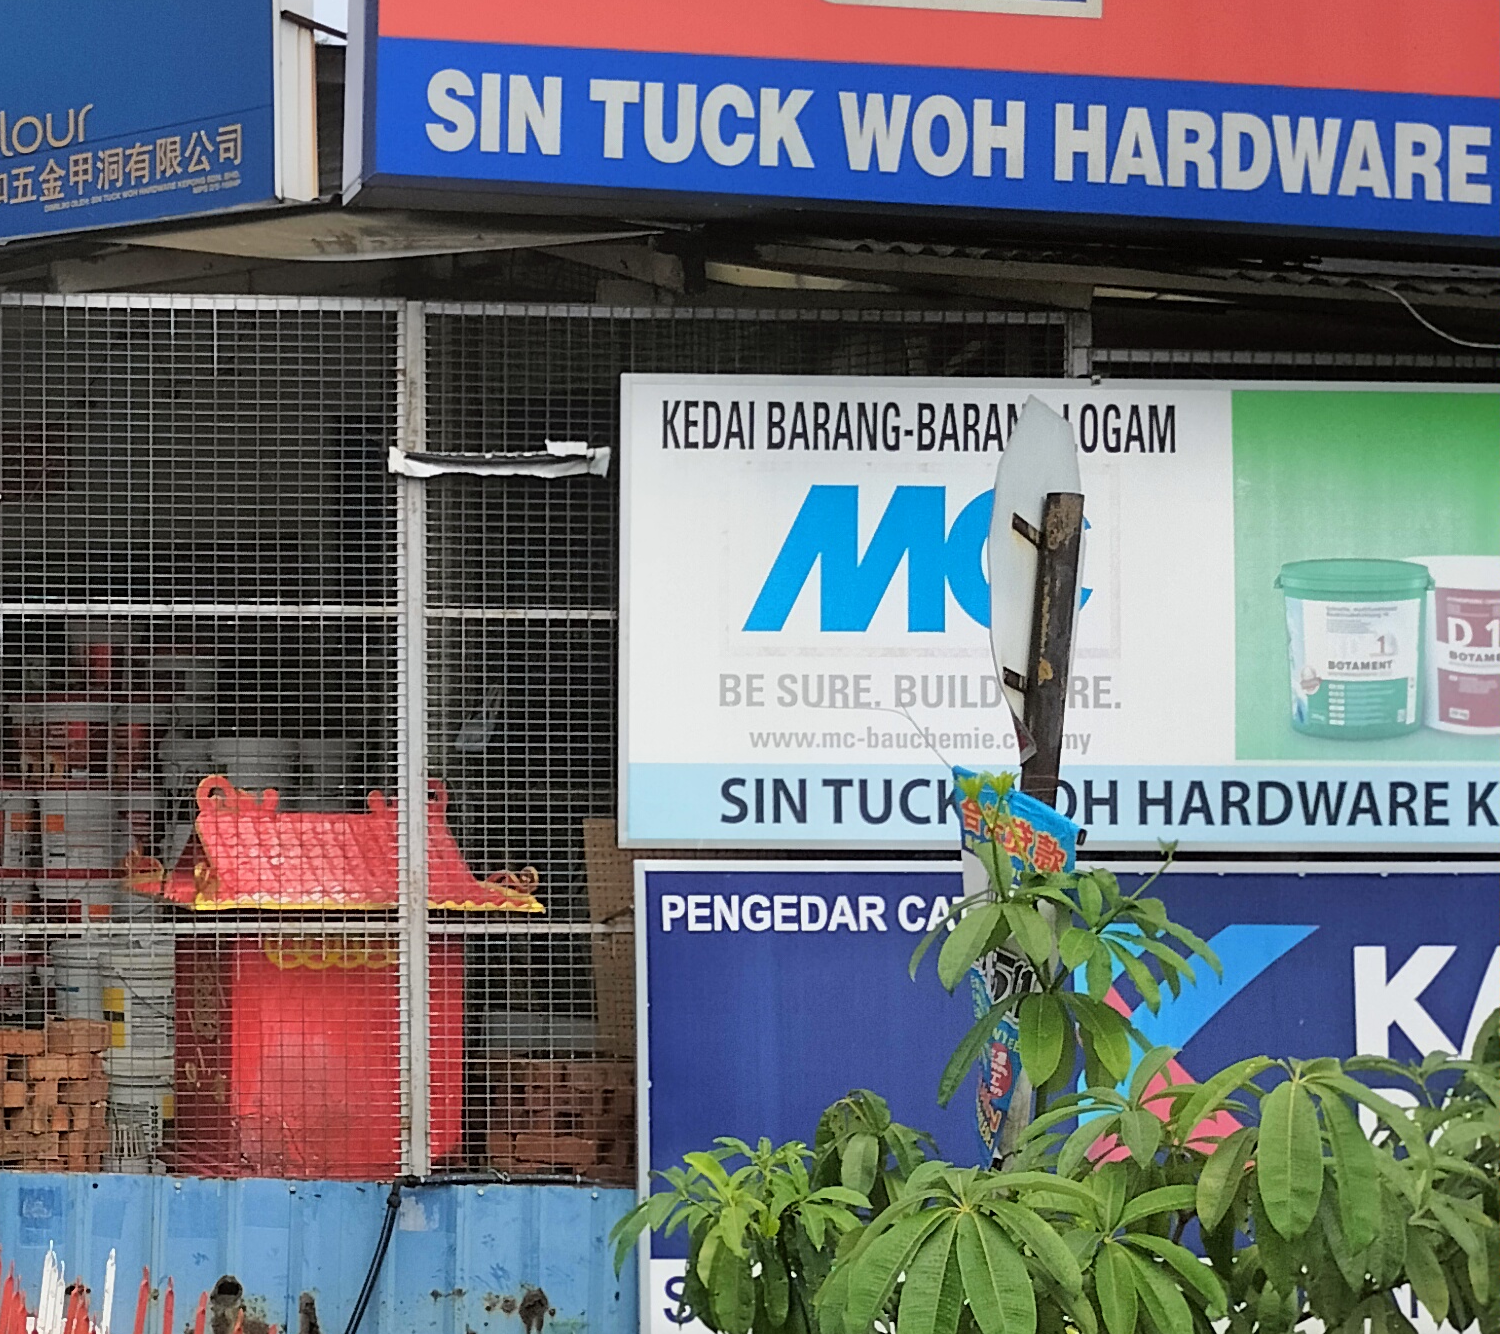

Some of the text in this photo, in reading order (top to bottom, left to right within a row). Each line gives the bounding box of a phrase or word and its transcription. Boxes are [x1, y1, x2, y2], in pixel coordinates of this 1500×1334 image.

[424, 68, 1492, 205] SIN TUCK WOH HARDWARE
[661, 399, 756, 451] KEDAI
[766, 401, 1026, 453] BARANG-BARAN
[718, 673, 766, 708] BE
[776, 673, 882, 709] SURE.
[894, 674, 1002, 709] BUILD
[749, 727, 1092, 756] www.mc-bauchemie.cmy
[720, 777, 808, 826] SIN
[822, 778, 957, 826] TUCK
[1138, 779, 1450, 827] HARDWARE
[1467, 780, 1500, 827] K
[660, 894, 888, 932] PENGEDAR
